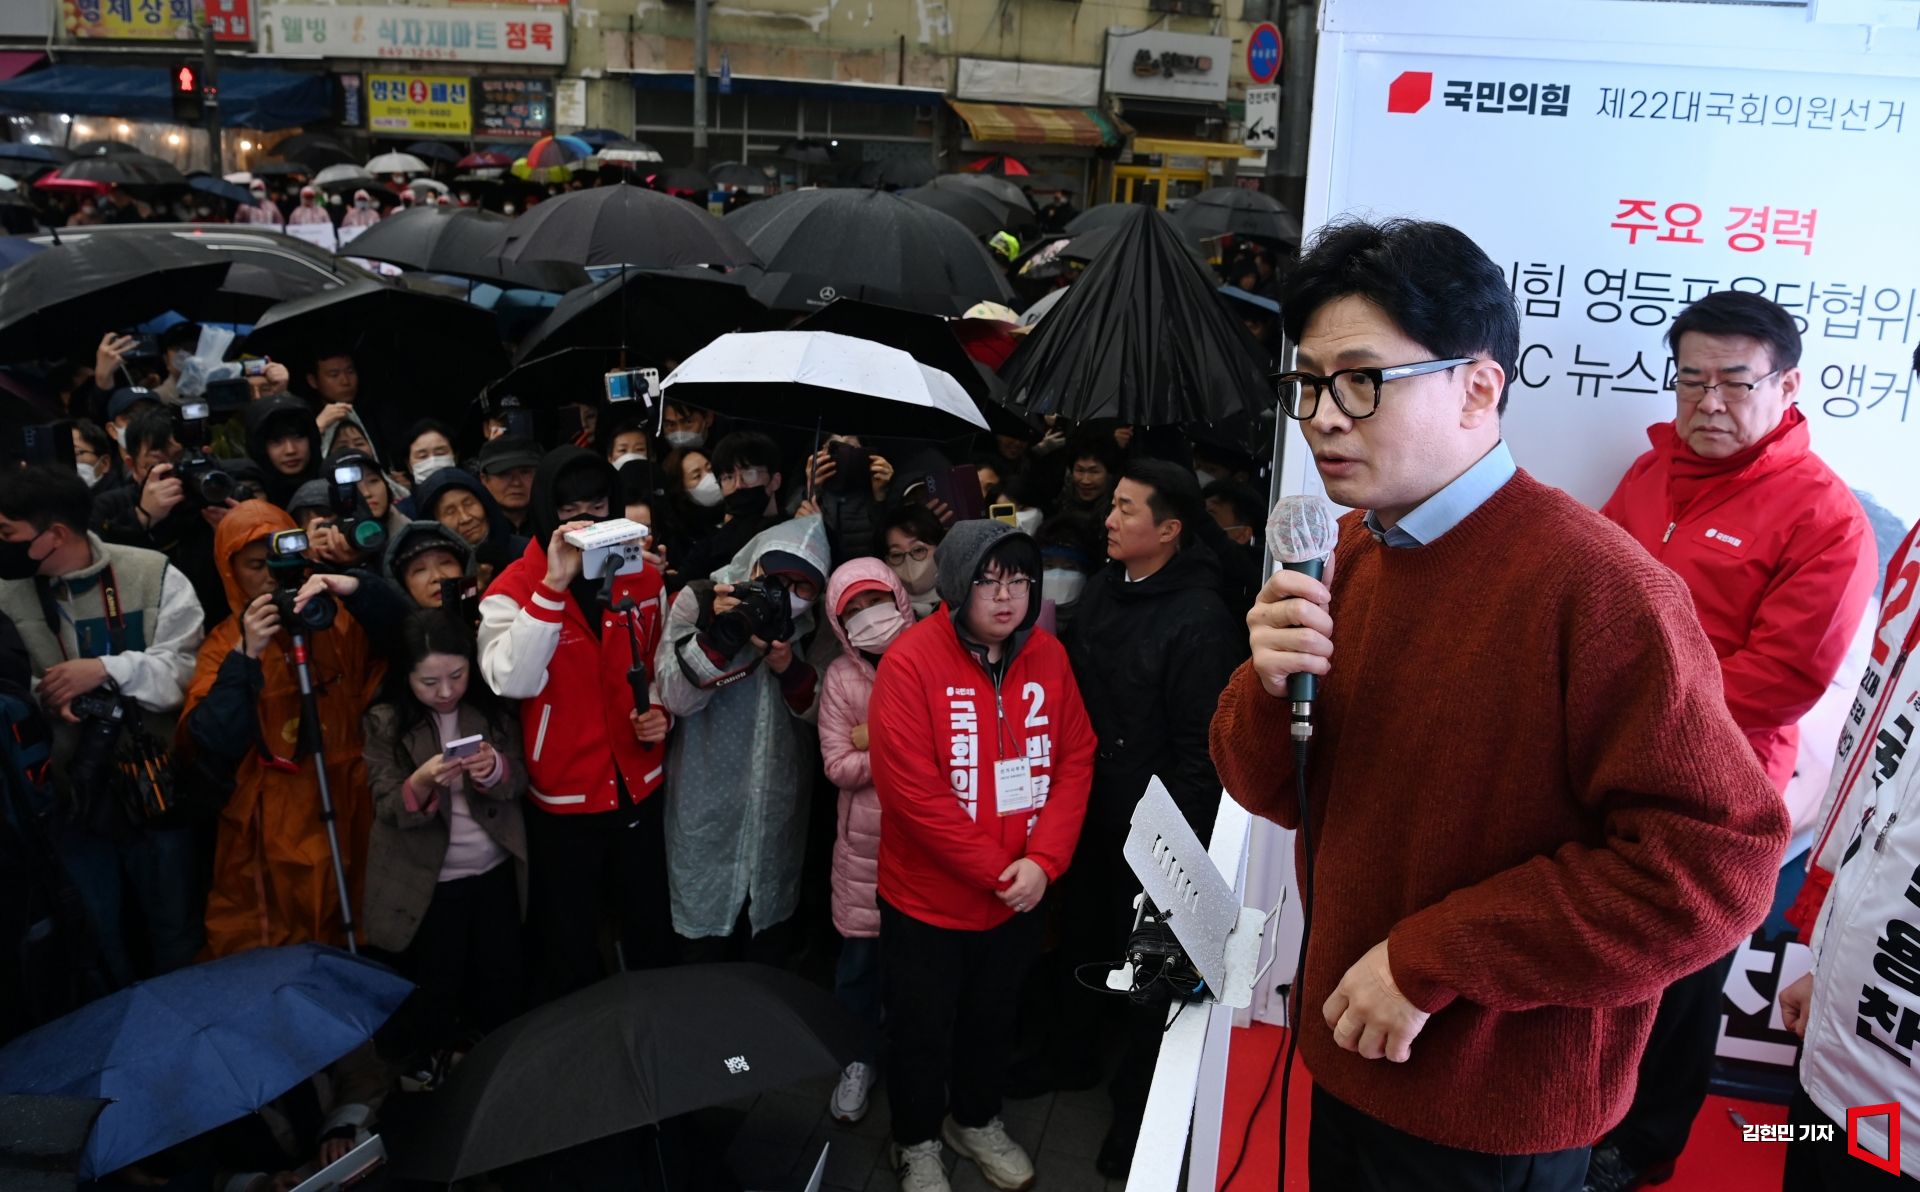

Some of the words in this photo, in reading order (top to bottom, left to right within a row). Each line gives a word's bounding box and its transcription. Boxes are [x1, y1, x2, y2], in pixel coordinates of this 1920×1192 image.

[281, 16, 327, 44] 웰빙
[378, 18, 497, 49] 식자재마트
[506, 21, 553, 51] 정육
[1443, 80, 1570, 117] 국민의힘
[1596, 85, 1905, 134] 제22대국회의원선거
[1610, 199, 1704, 245] 주요
[1724, 206, 1818, 255] 경력
[1821, 364, 1913, 422] 앵커
[1870, 560, 1920, 666] 2
[716, 671, 747, 687] Canon
[1021, 681, 1049, 728] 2
